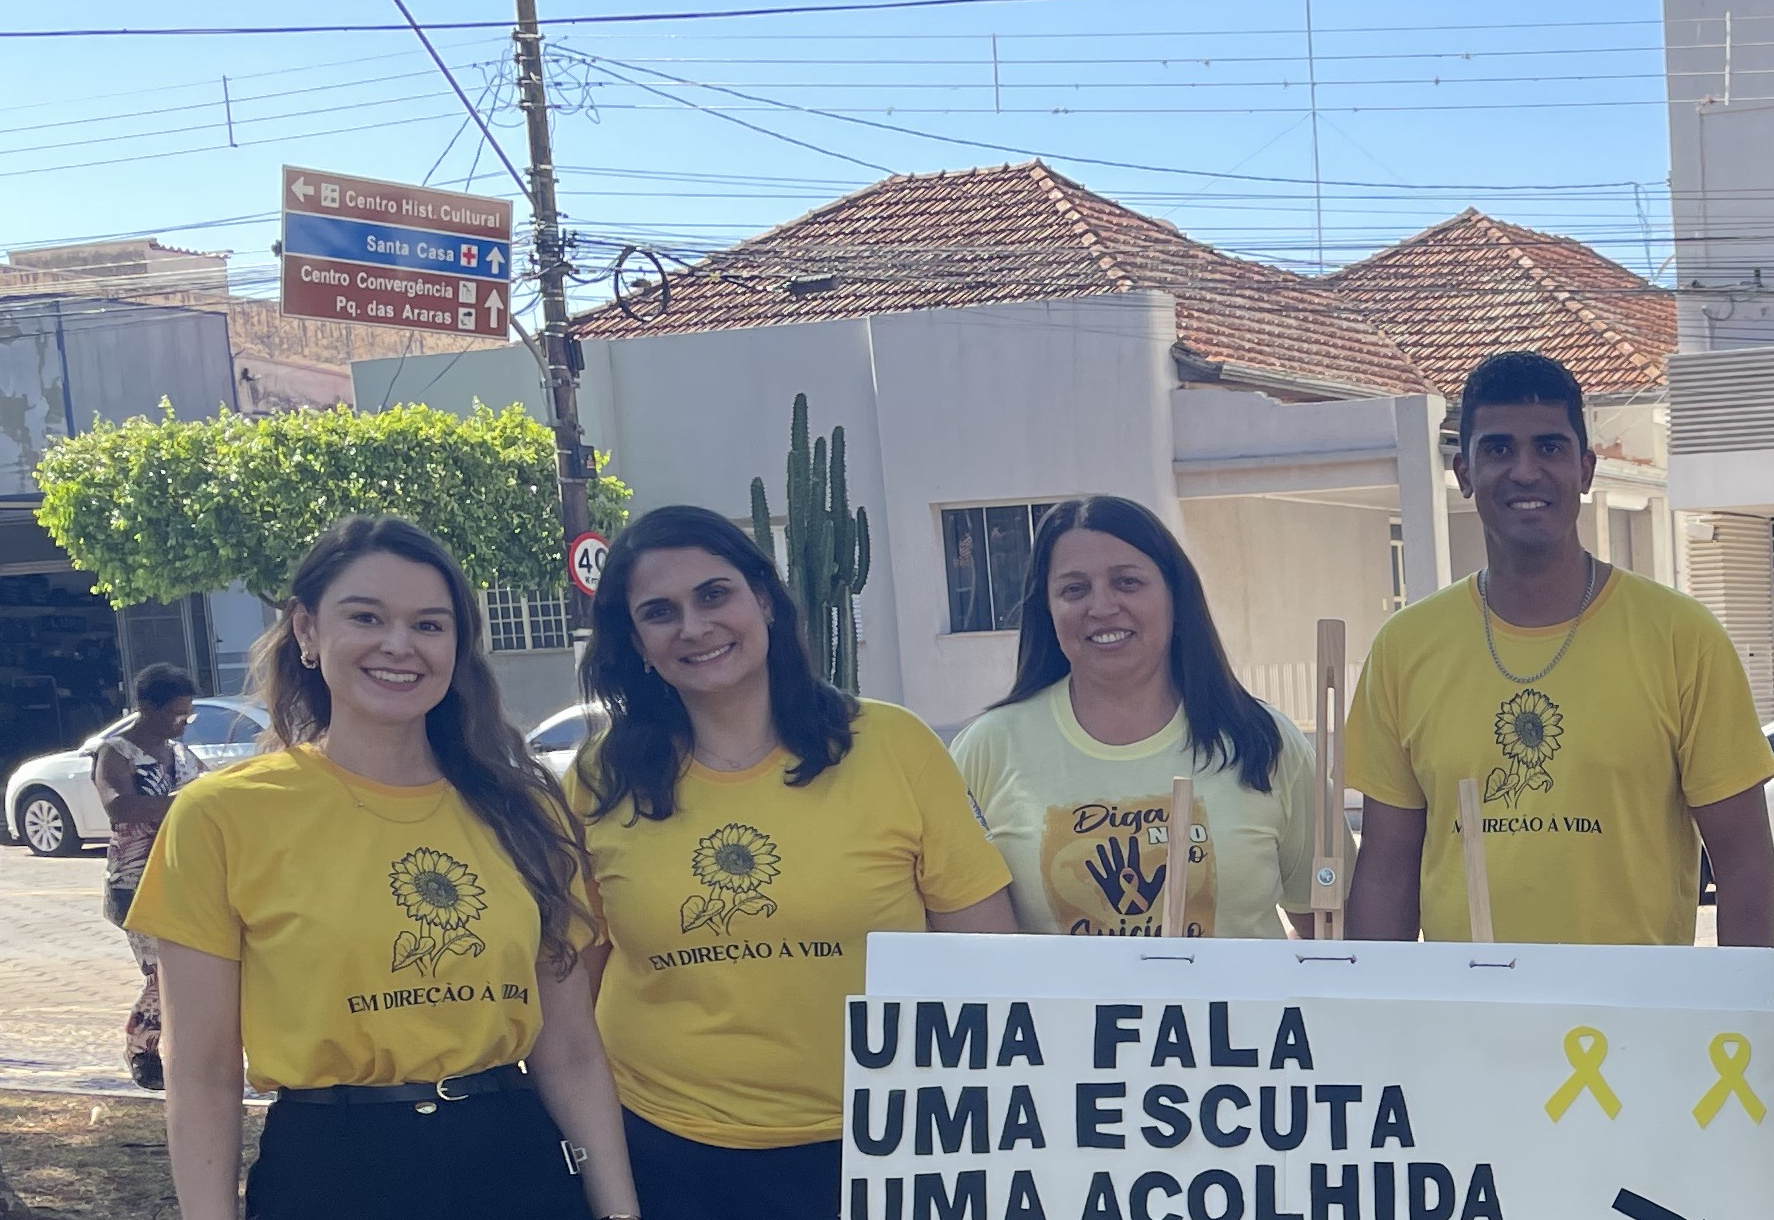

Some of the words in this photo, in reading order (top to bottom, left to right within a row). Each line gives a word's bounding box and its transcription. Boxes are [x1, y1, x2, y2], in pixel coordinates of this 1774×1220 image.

[345, 190, 397, 214] Centro
[402, 198, 438, 220] Hist.
[440, 205, 500, 228] Cultural
[366, 235, 410, 256] Santa
[417, 242, 455, 262] Casa
[301, 265, 350, 286] Centro
[357, 272, 454, 299] Convergência
[336, 296, 361, 317] Pq.
[367, 300, 395, 318] das
[402, 304, 452, 324] Araras
[1072, 804, 1170, 834] Diga
[1147, 823, 1208, 845] NO
[1482, 814, 1543, 836] IREÇÃO
[1562, 817, 1603, 835] VIDA
[647, 952, 678, 971] EM
[677, 939, 773, 966] DIREÇÃO
[798, 941, 844, 958] VIDA
[347, 994, 379, 1014] EM
[382, 982, 474, 1010] DIREÇÃO
[501, 983, 530, 1005] IDA
[850, 1001, 1043, 1069] UMA
[1094, 1002, 1313, 1069] FALA
[853, 1085, 1045, 1156] UMA
[1076, 1082, 1414, 1151] ESCUTA
